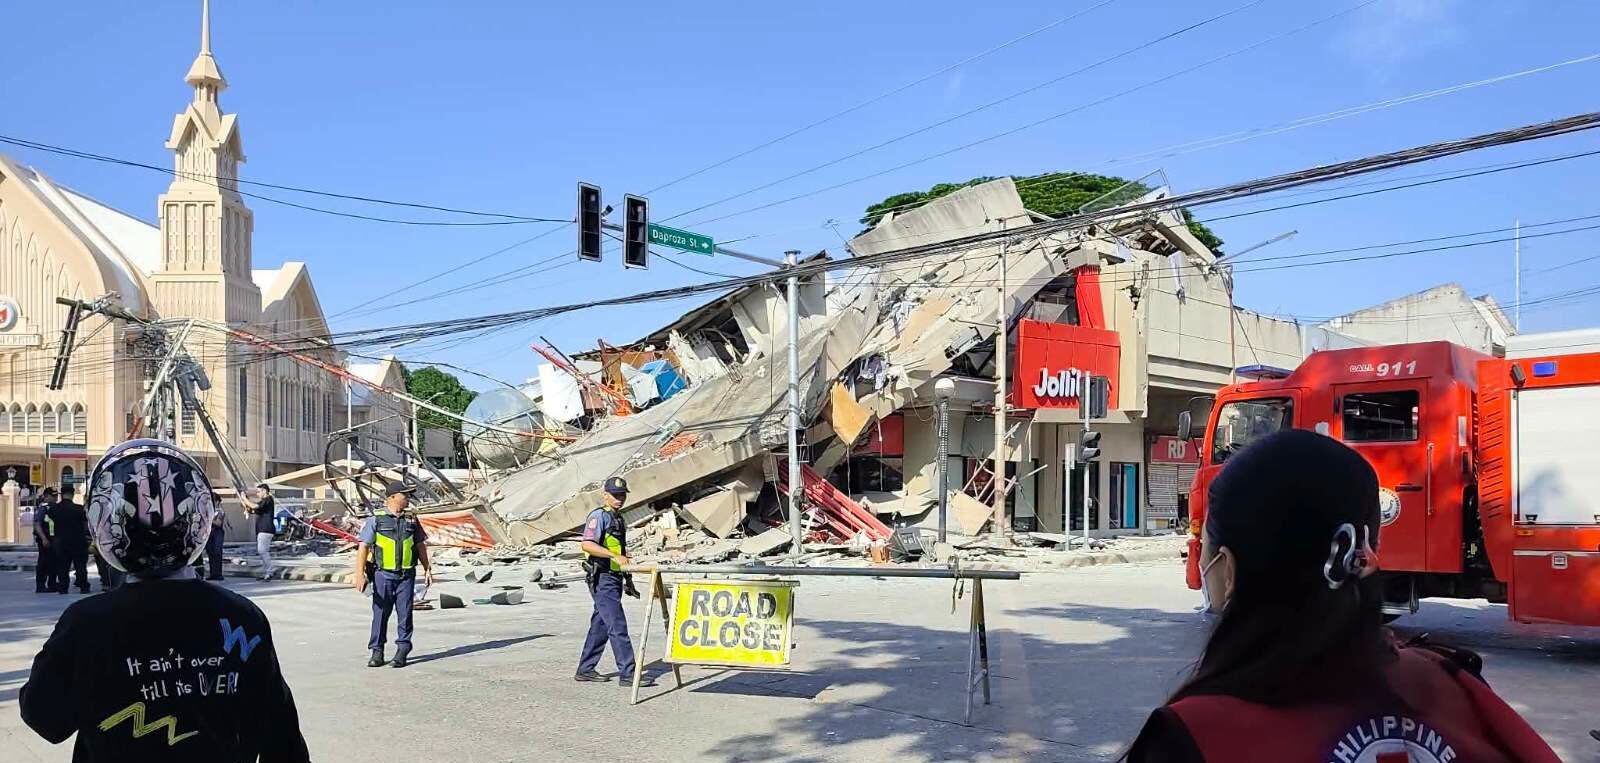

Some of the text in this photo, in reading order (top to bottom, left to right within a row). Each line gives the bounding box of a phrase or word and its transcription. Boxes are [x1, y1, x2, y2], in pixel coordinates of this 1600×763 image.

[652, 229, 686, 245] Daproza
[1032, 367, 1088, 398] Jolli
[1349, 360, 1417, 377] CALL 911
[1167, 439, 1187, 459] RD
[690, 588, 777, 620] ROAD
[679, 619, 783, 652] CLOSE
[126, 647, 225, 677] It ain't over
[140, 679, 169, 701] till
[175, 679, 193, 697] its
[1329, 715, 1457, 763] HILIPPINE
